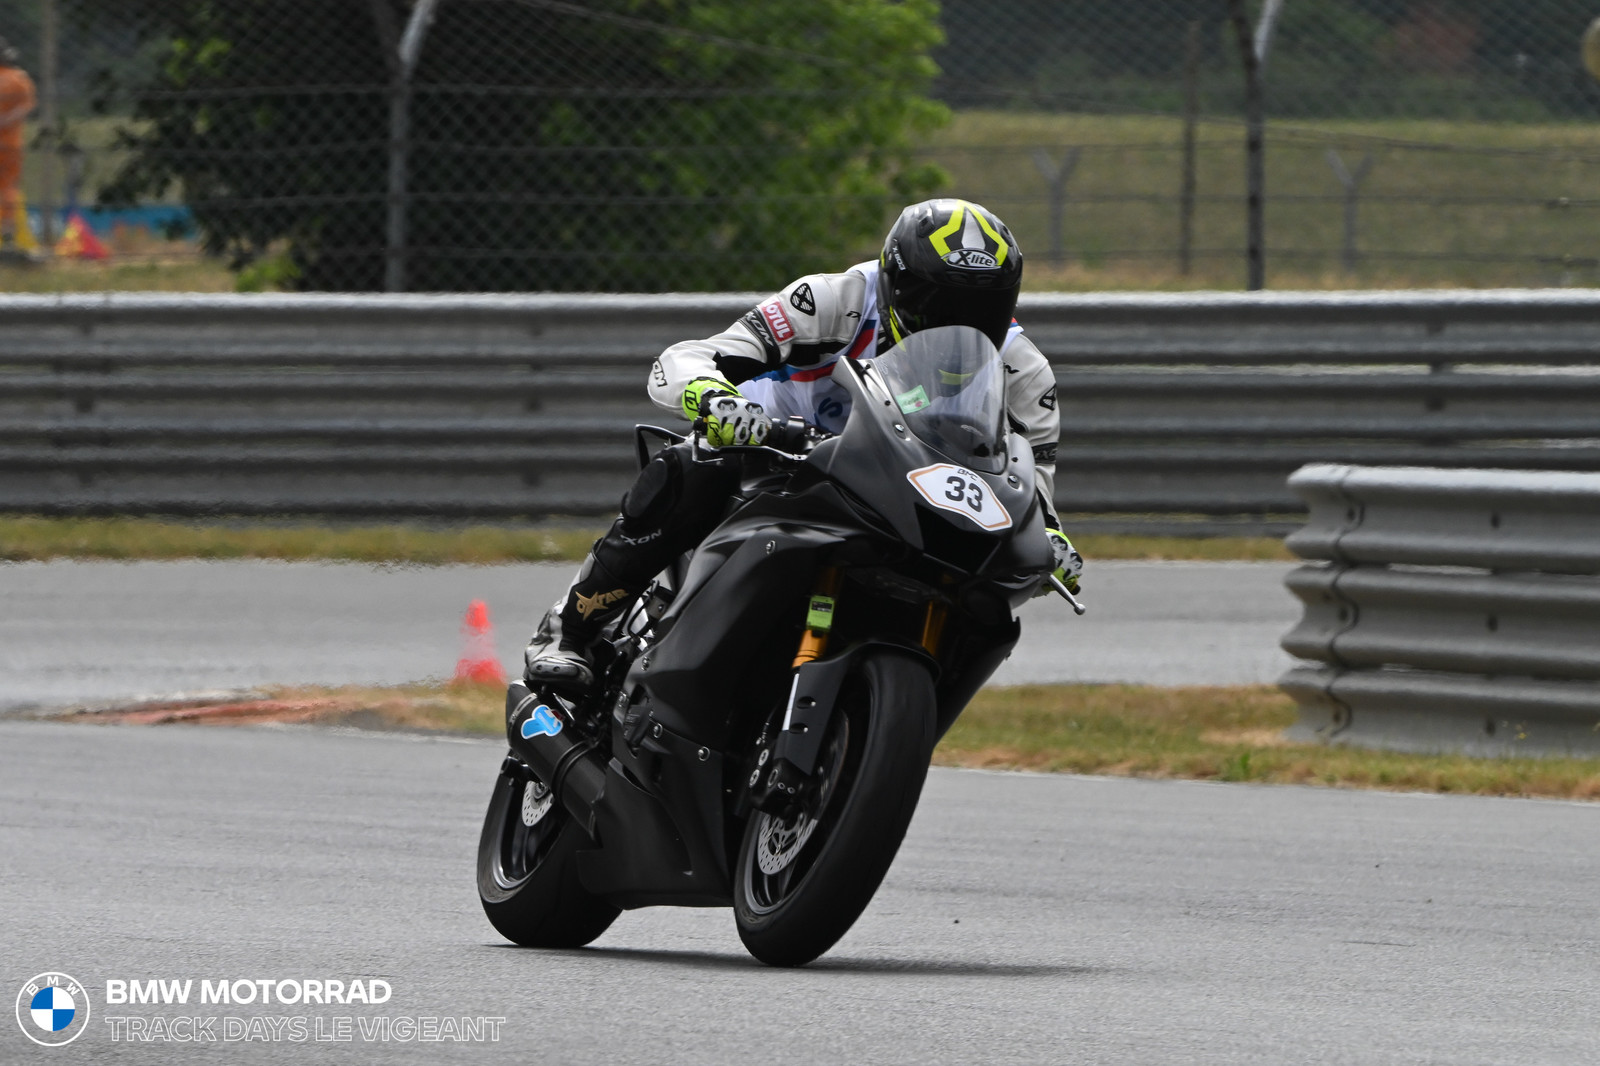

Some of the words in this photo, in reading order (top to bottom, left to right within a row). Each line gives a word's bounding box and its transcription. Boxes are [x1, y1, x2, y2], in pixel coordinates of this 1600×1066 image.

[950, 251, 993, 266] X-lite
[744, 311, 775, 347] XON
[764, 302, 791, 339] OTUL
[945, 476, 983, 513] 33
[620, 529, 662, 546] XON
